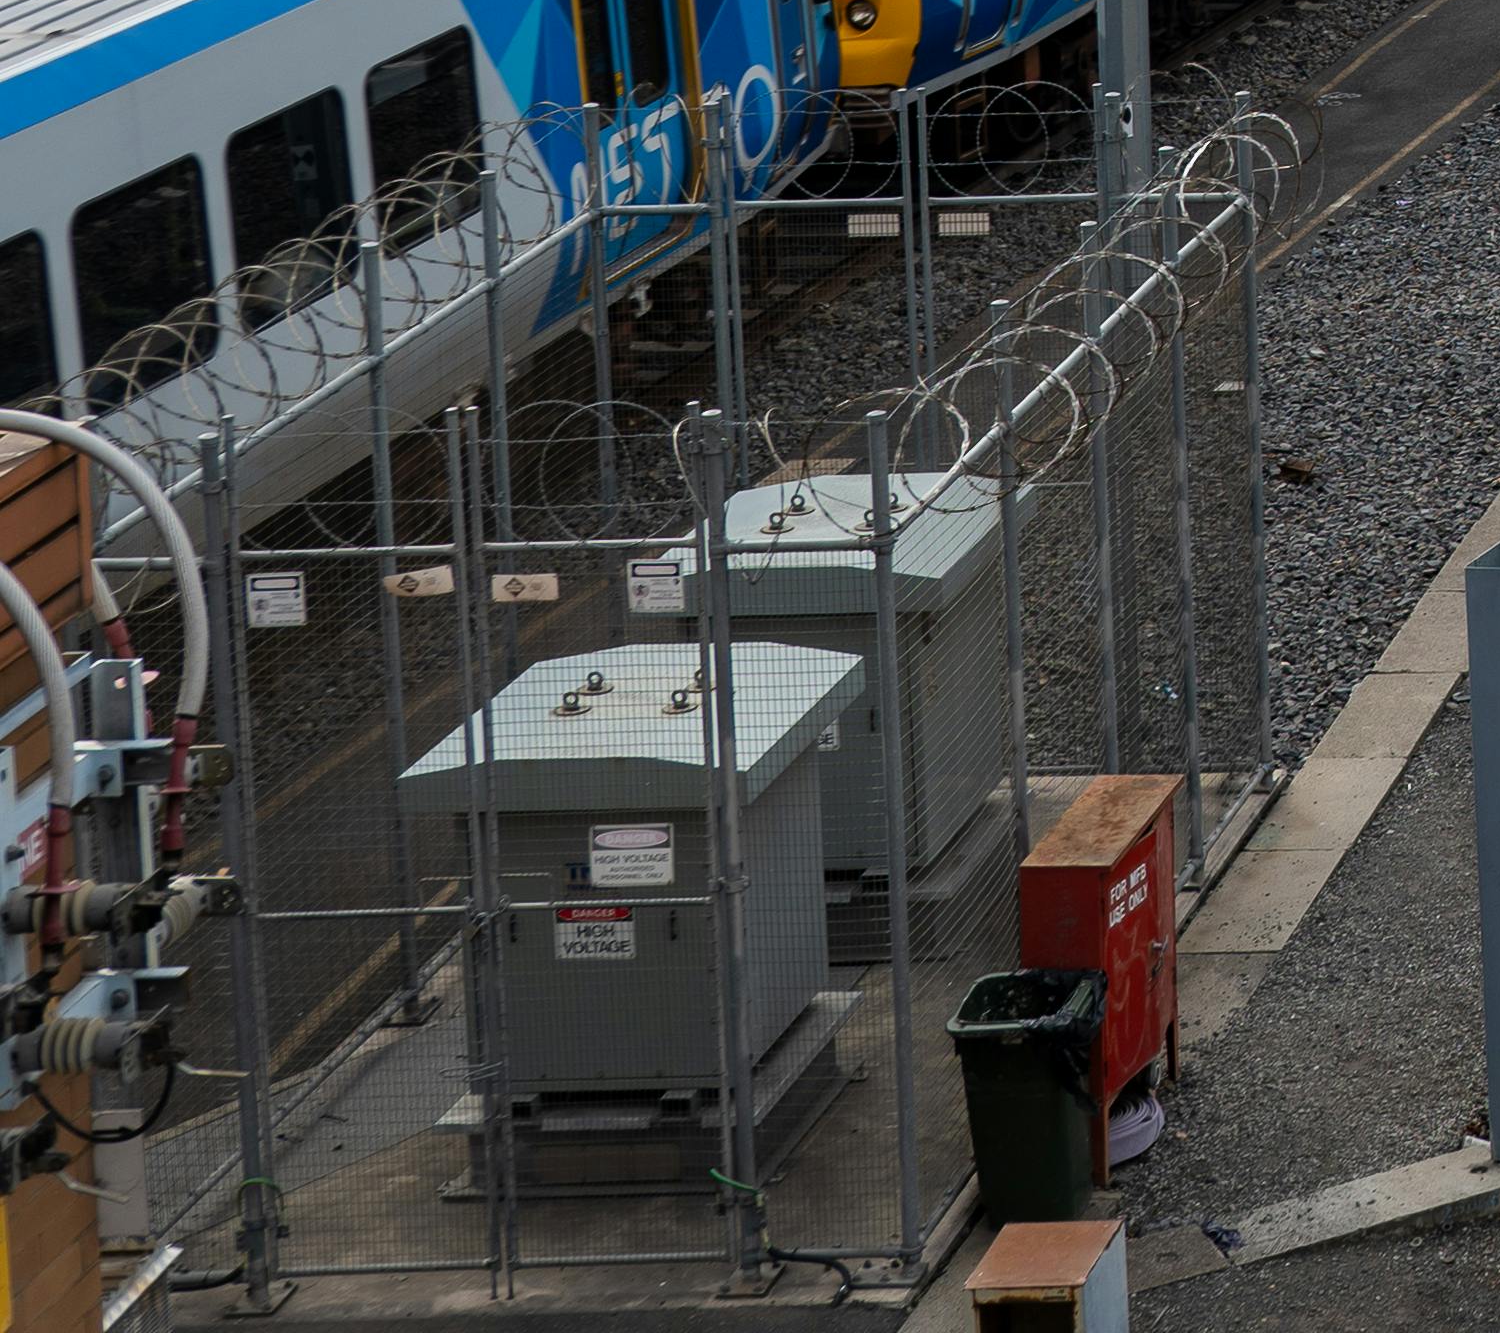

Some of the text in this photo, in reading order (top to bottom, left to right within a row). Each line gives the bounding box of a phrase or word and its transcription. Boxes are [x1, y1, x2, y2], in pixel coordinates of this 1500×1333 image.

[594, 852, 670, 864] HIGH VOLTAGE
[1110, 878, 1127, 905] FOR
[571, 908, 616, 918] DANGER
[1109, 884, 1149, 929] USE ONLY
[576, 924, 616, 939] HIGH
[562, 939, 632, 955] VOLTAGE
